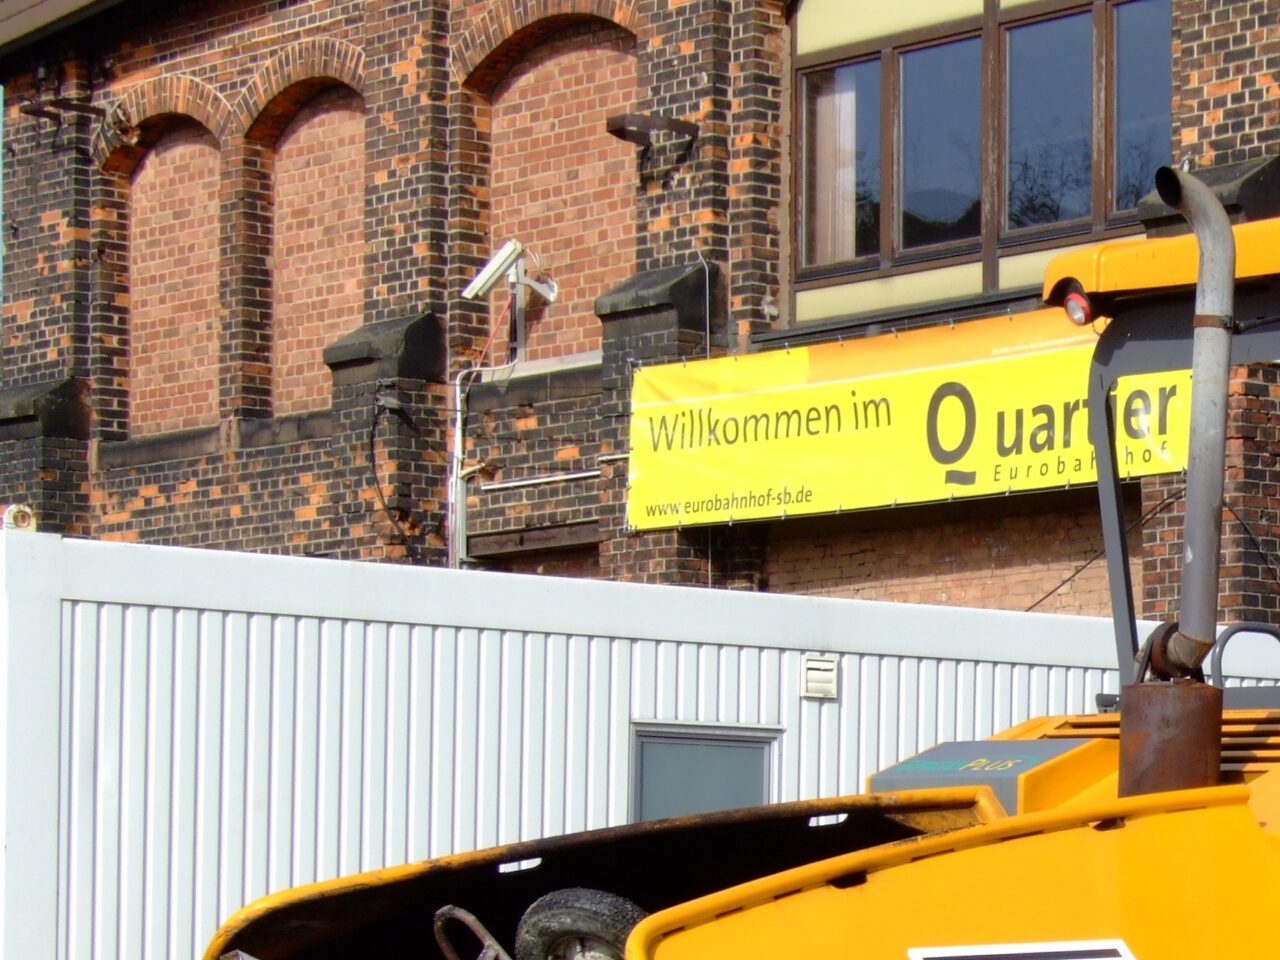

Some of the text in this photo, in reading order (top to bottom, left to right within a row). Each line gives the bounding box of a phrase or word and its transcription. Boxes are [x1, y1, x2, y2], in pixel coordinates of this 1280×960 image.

[649, 379, 1177, 486] Willkommen im Quarier
[993, 440, 1168, 482] Eurobahhof
[645, 484, 813, 518] wwweurobahnhof-sb.de
